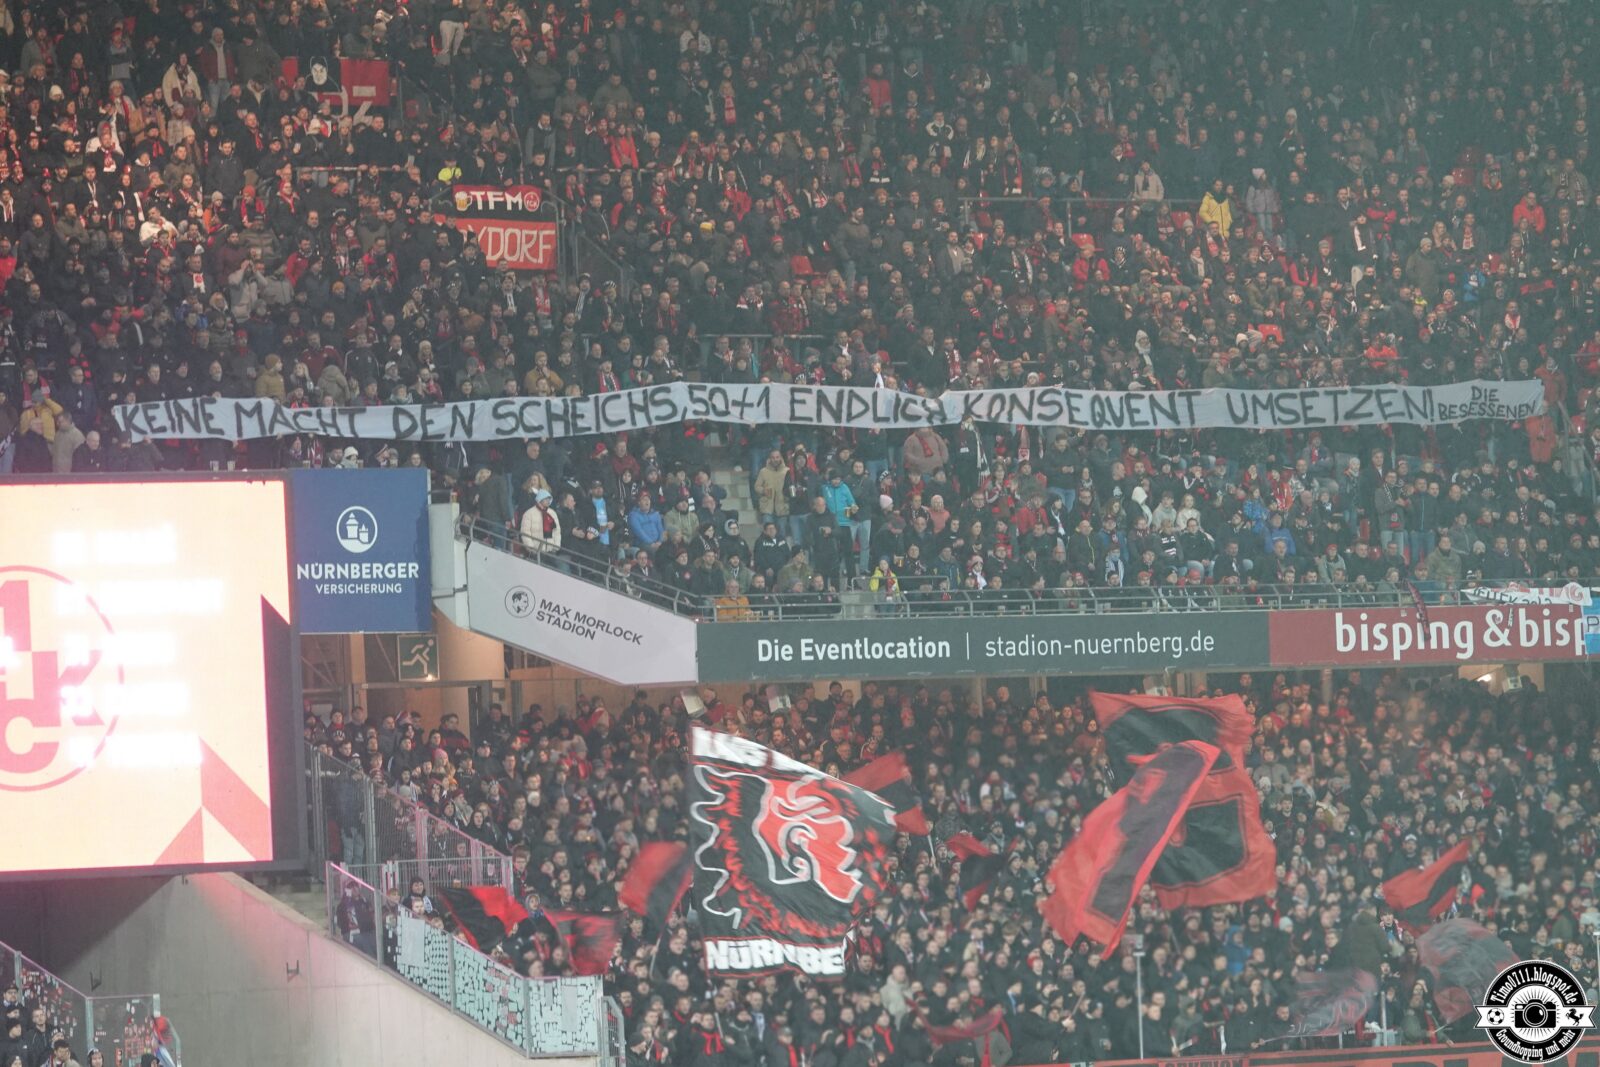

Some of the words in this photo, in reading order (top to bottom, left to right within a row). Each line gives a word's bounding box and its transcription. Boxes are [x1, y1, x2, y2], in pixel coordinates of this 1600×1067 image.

[470, 191, 522, 211] TFM
[1471, 386, 1499, 402] DIE
[121, 398, 224, 435] KEINE
[234, 400, 367, 438] MACHT
[392, 402, 475, 440] DEN
[688, 384, 770, 421] 50+1
[789, 386, 948, 424] ENDLICH
[963, 388, 1202, 428] KONSEQUENT
[1226, 387, 1434, 424] UMSETZEN!
[1438, 400, 1536, 420] BESESSENEN
[297, 562, 419, 580] NÜRNBERGER
[316, 583, 402, 594] VERSICHERUNG
[536, 611, 596, 640] STADION
[539, 599, 572, 618] MAX
[574, 611, 643, 645] MORLOCK
[758, 639, 793, 661] Die
[800, 636, 950, 661] Eventlocation
[985, 630, 1215, 658] stadion-nuernberg.de
[1335, 612, 1473, 660] bisping
